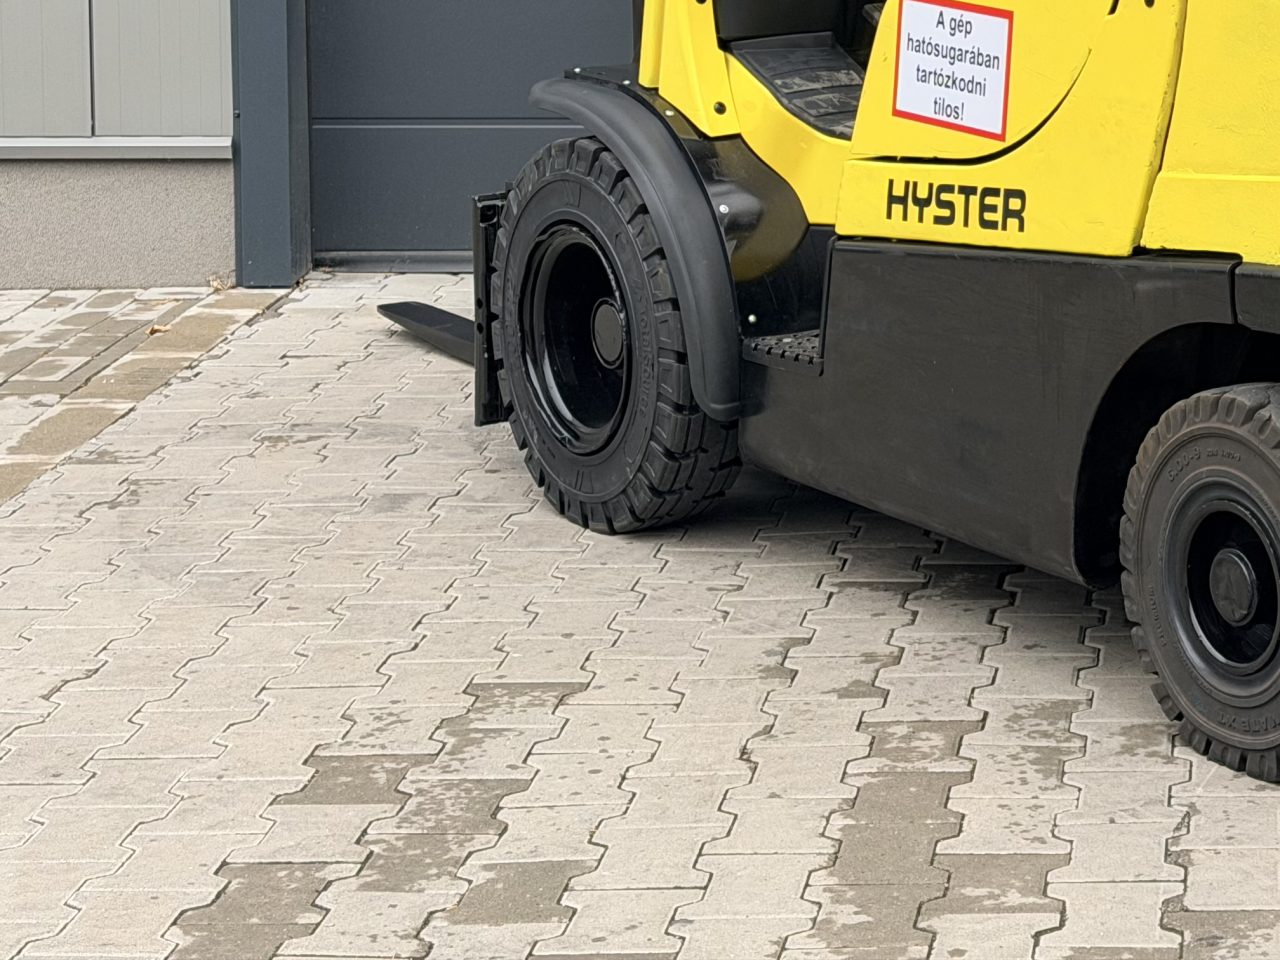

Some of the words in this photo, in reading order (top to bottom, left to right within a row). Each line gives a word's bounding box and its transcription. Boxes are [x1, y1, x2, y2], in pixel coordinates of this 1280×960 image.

[935, 11, 946, 28] A
[949, 15, 974, 38] gép
[906, 32, 1001, 71] hatósugarában
[915, 64, 987, 97] tartózkodni
[932, 98, 965, 122] tilos!
[886, 179, 1026, 232] HYSTER
